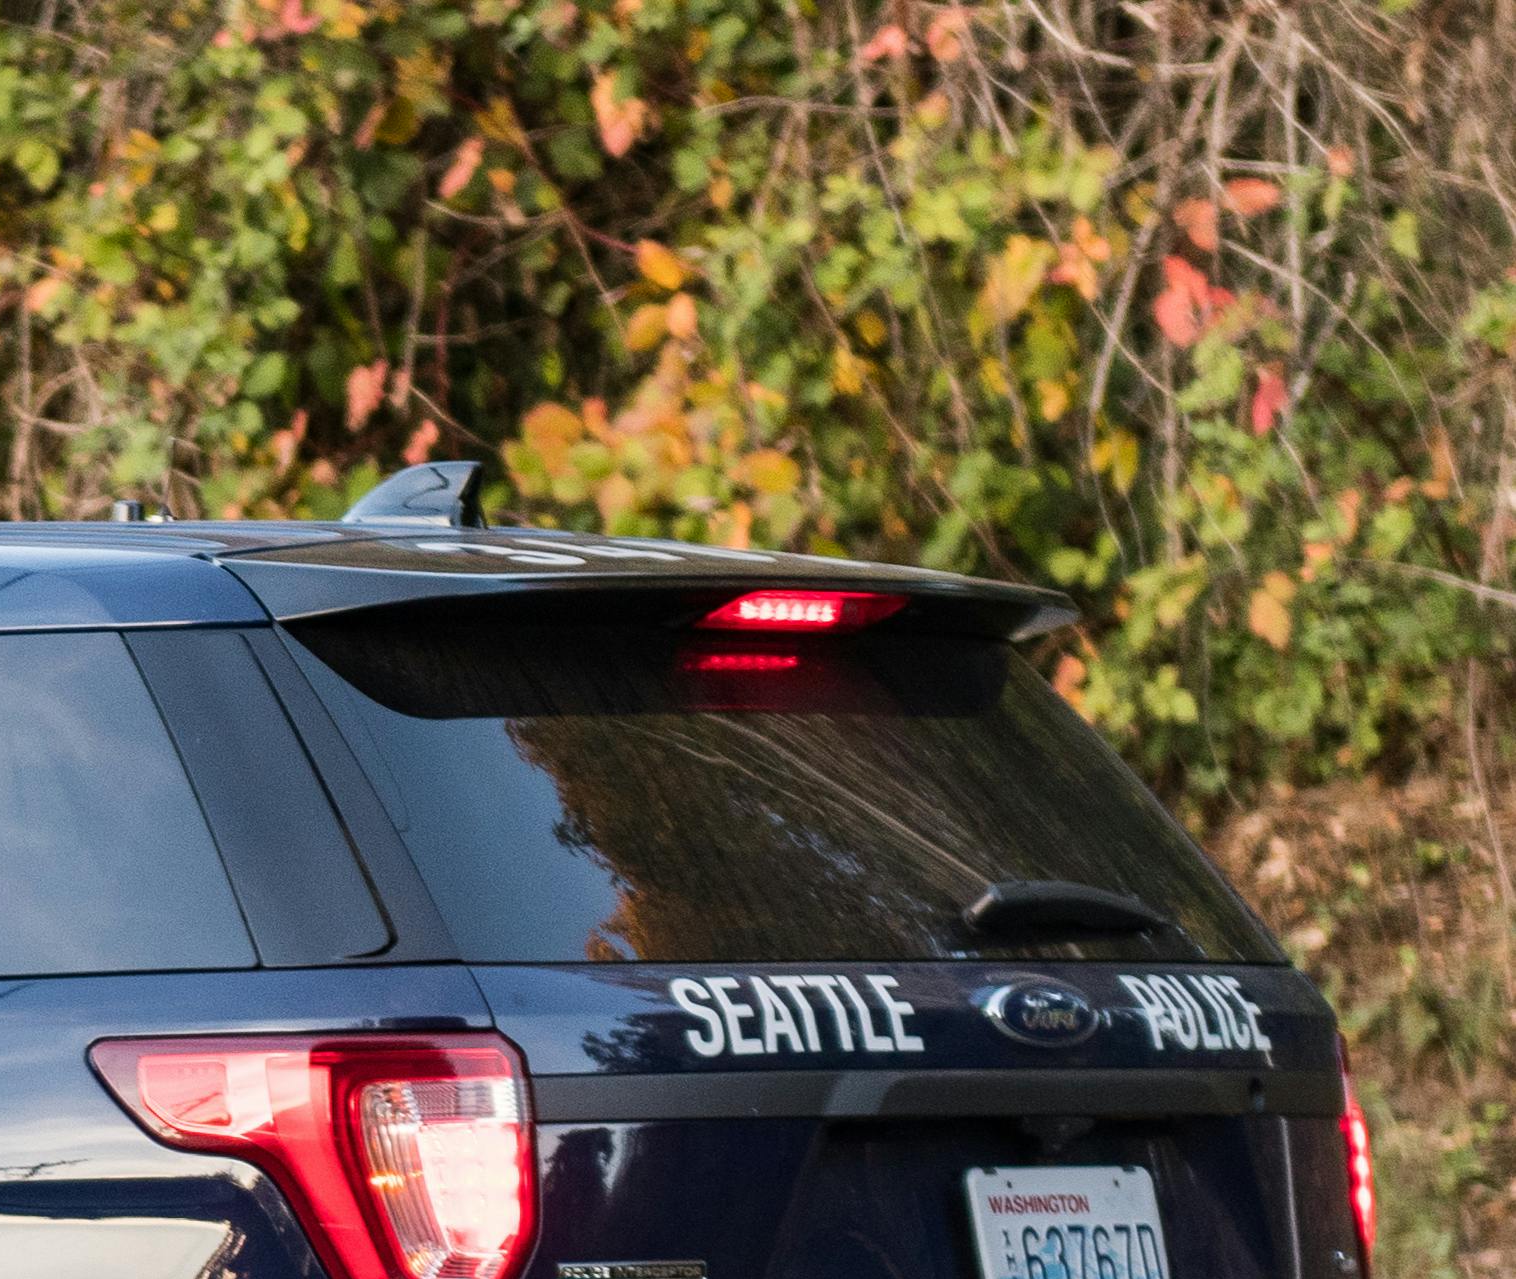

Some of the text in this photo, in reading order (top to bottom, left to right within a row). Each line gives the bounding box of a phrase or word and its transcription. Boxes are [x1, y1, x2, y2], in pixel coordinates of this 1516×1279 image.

[670, 974, 1272, 1057] SEATTLE POLICE
[988, 1195, 1090, 1214] WASHINGTON
